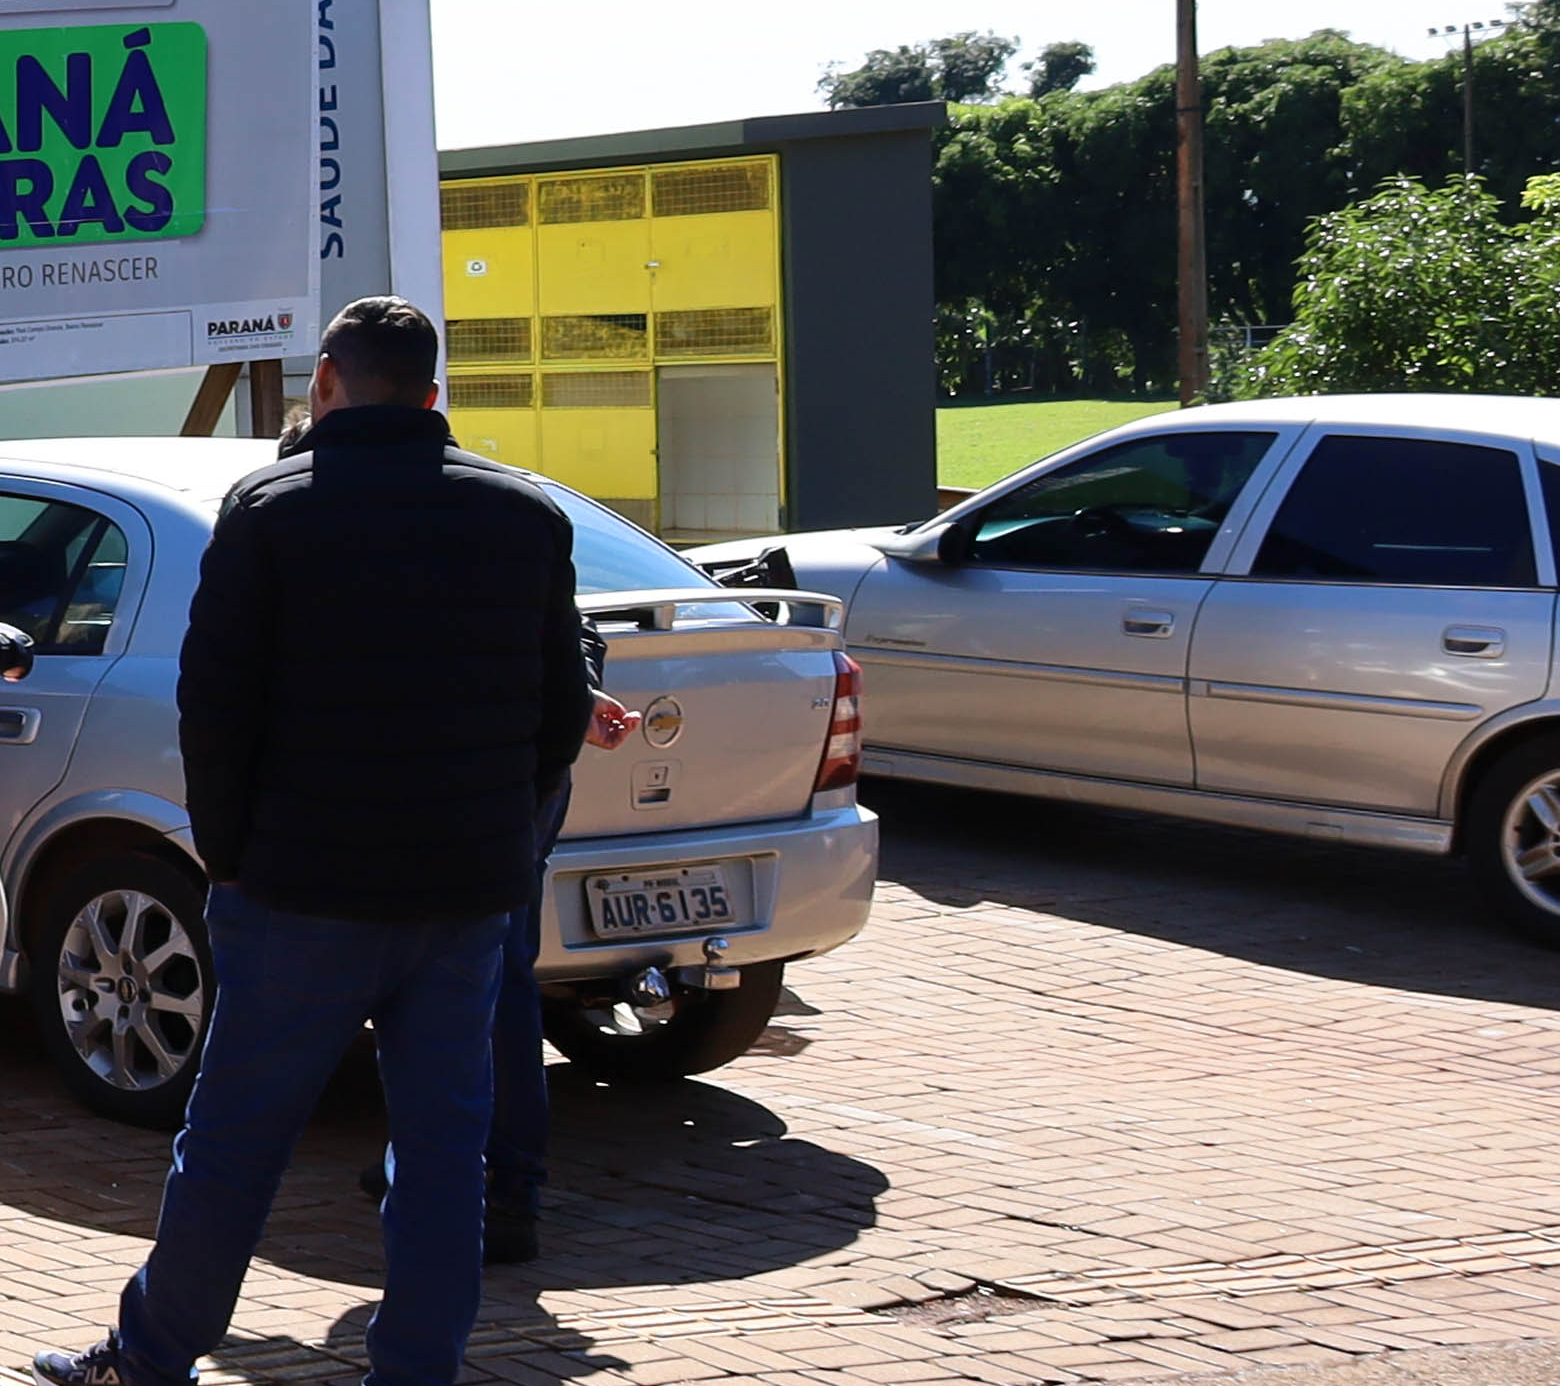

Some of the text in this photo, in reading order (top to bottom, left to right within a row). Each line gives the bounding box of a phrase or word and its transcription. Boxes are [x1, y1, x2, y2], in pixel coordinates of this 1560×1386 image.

[41, 256, 159, 287] RENASCER
[207, 314, 276, 337] PARANÁ
[68, 1365, 121, 1385] FILA
